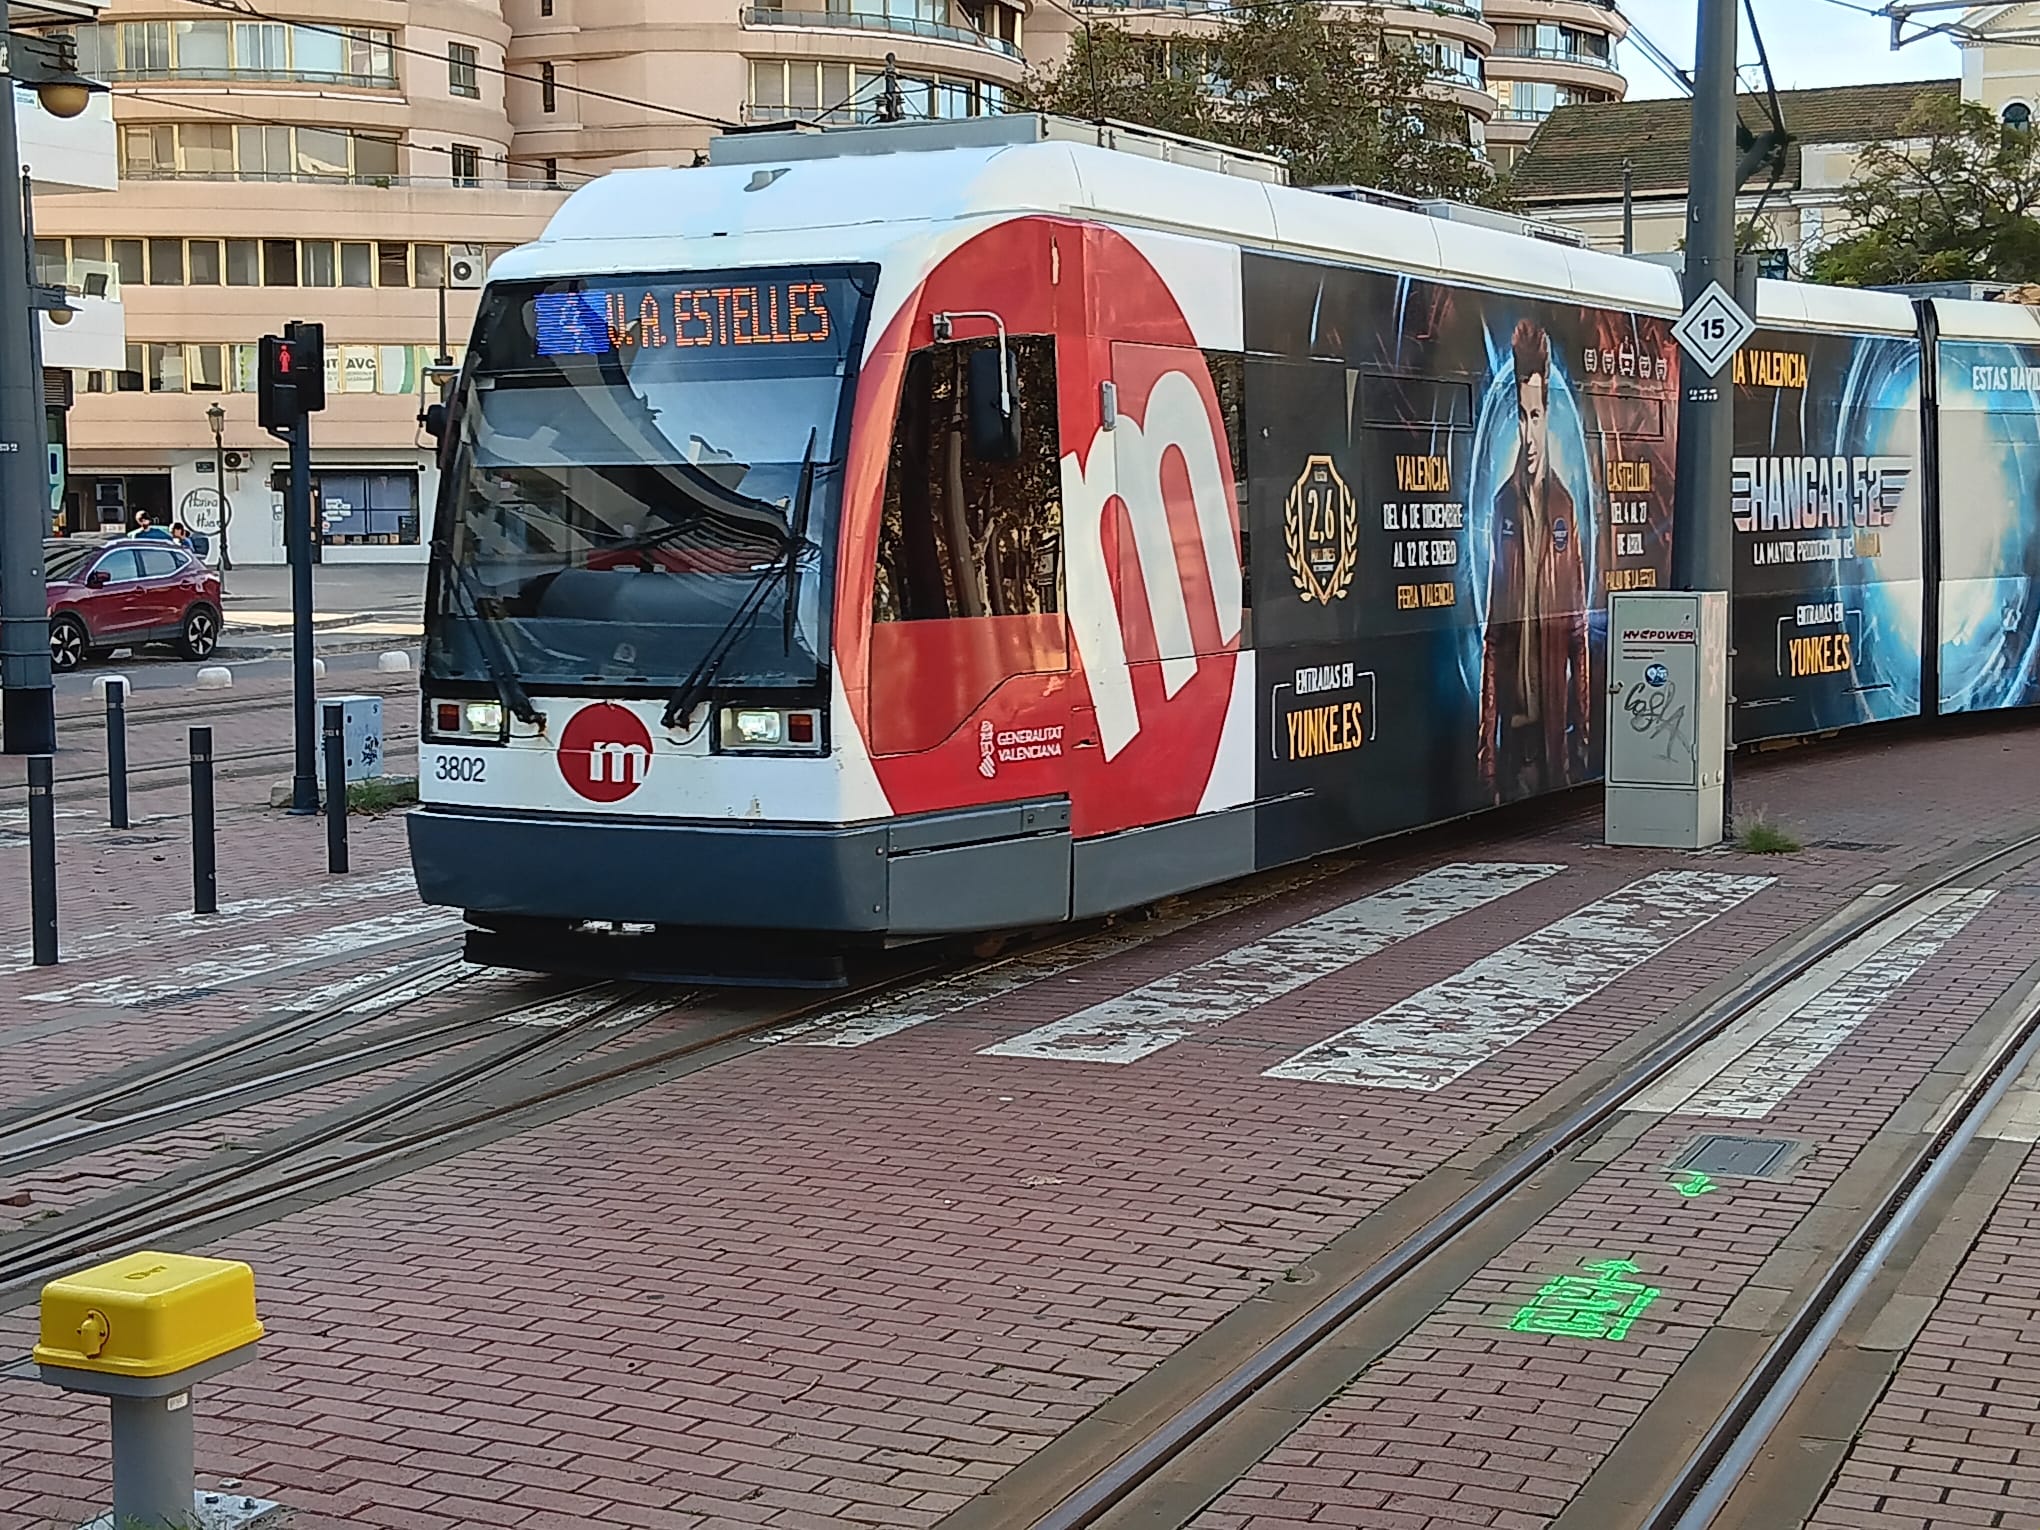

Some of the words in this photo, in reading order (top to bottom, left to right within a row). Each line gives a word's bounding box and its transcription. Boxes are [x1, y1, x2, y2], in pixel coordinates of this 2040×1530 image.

[674, 283, 829, 347] ESTELLES
[1700, 318, 1725, 340] 15
[1750, 350, 1808, 388] VALENCIA
[1972, 366, 2008, 391] ESTAS
[1396, 455, 1450, 491] VALENCIA
[1607, 457, 1651, 492] CASTELLÓN
[1750, 457, 1849, 532] HANGAR
[1853, 457, 1882, 527] 52
[1308, 489, 1335, 545] 2,6
[1383, 503, 1400, 530] DEL
[1402, 503, 1407, 530] 6
[1410, 503, 1421, 530] DE
[1061, 370, 1243, 763] m
[1393, 541, 1406, 568] AL
[1406, 541, 1417, 567] 12
[1418, 541, 1430, 567] DE
[1431, 540, 1457, 566] ENERO
[1753, 543, 1766, 565] LA
[1766, 541, 1796, 564] MAYOR
[1397, 585, 1420, 609] FERIA
[1420, 582, 1456, 608] VALENCIA
[1797, 603, 1833, 626] ENTRADAS
[1834, 602, 1844, 623] EN
[1789, 633, 1850, 677] YUNKE.ES
[1296, 665, 1341, 695] ENTRADAS
[1342, 662, 1354, 688] EN
[996, 725, 1065, 746] GENERALITAT
[1286, 701, 1362, 760] YUNKE.ES
[589, 741, 648, 784] m
[998, 742, 1063, 762] VALENCIANA
[435, 755, 487, 783] 3802
